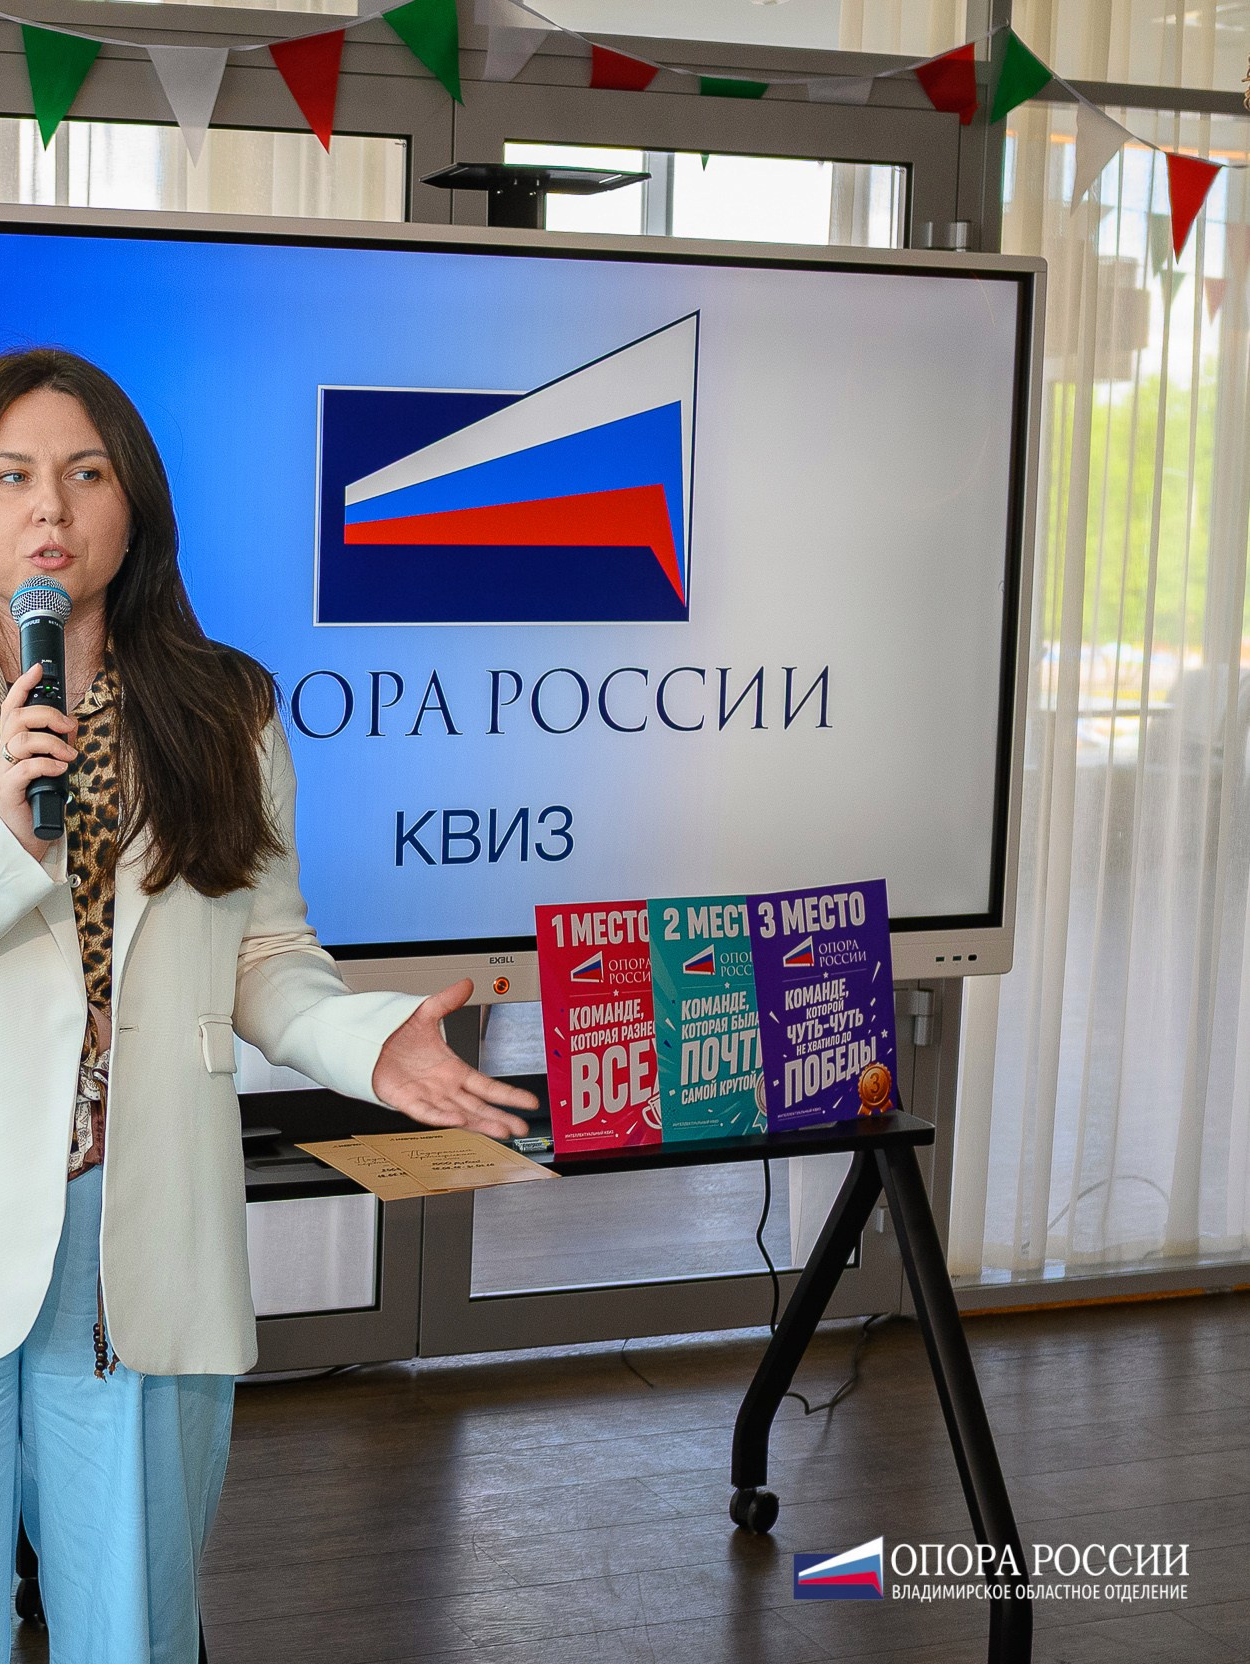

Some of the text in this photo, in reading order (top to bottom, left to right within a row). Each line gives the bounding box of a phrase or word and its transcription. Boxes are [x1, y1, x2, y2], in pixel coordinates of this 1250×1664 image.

[270, 665, 833, 739] ОРА РОССИИ
[395, 805, 575, 867] КВИЗ
[551, 908, 650, 948] 1 МЕСТО
[663, 904, 750, 940] 2 МЕСТ
[758, 891, 866, 938] 3 МЕСТО
[720, 951, 752, 964] ОПО
[818, 939, 859, 955] ОПОРА
[819, 951, 867, 967] РОССИИ
[609, 970, 651, 984] РОССИ
[720, 965, 752, 977] РОСС
[681, 991, 749, 1021] КОМАНДЕ,
[785, 978, 849, 1011] КОМАНДЕ,
[806, 998, 844, 1019] КОТОРОЙ
[569, 999, 644, 1031] КОМАНДЕ,
[681, 1016, 728, 1040] КОТОРАЯ
[787, 1008, 864, 1045] ЧУТЬ-ЧУТЬ
[570, 1027, 619, 1052] КОТОРАЯ
[796, 1031, 852, 1056] НЕ ХВАТИЛО ДО
[785, 1036, 877, 1108] ПОБЕДЫ
[870, 1072, 880, 1094] 3
[681, 1070, 756, 1105] САМОЙ КРУТОЙ
